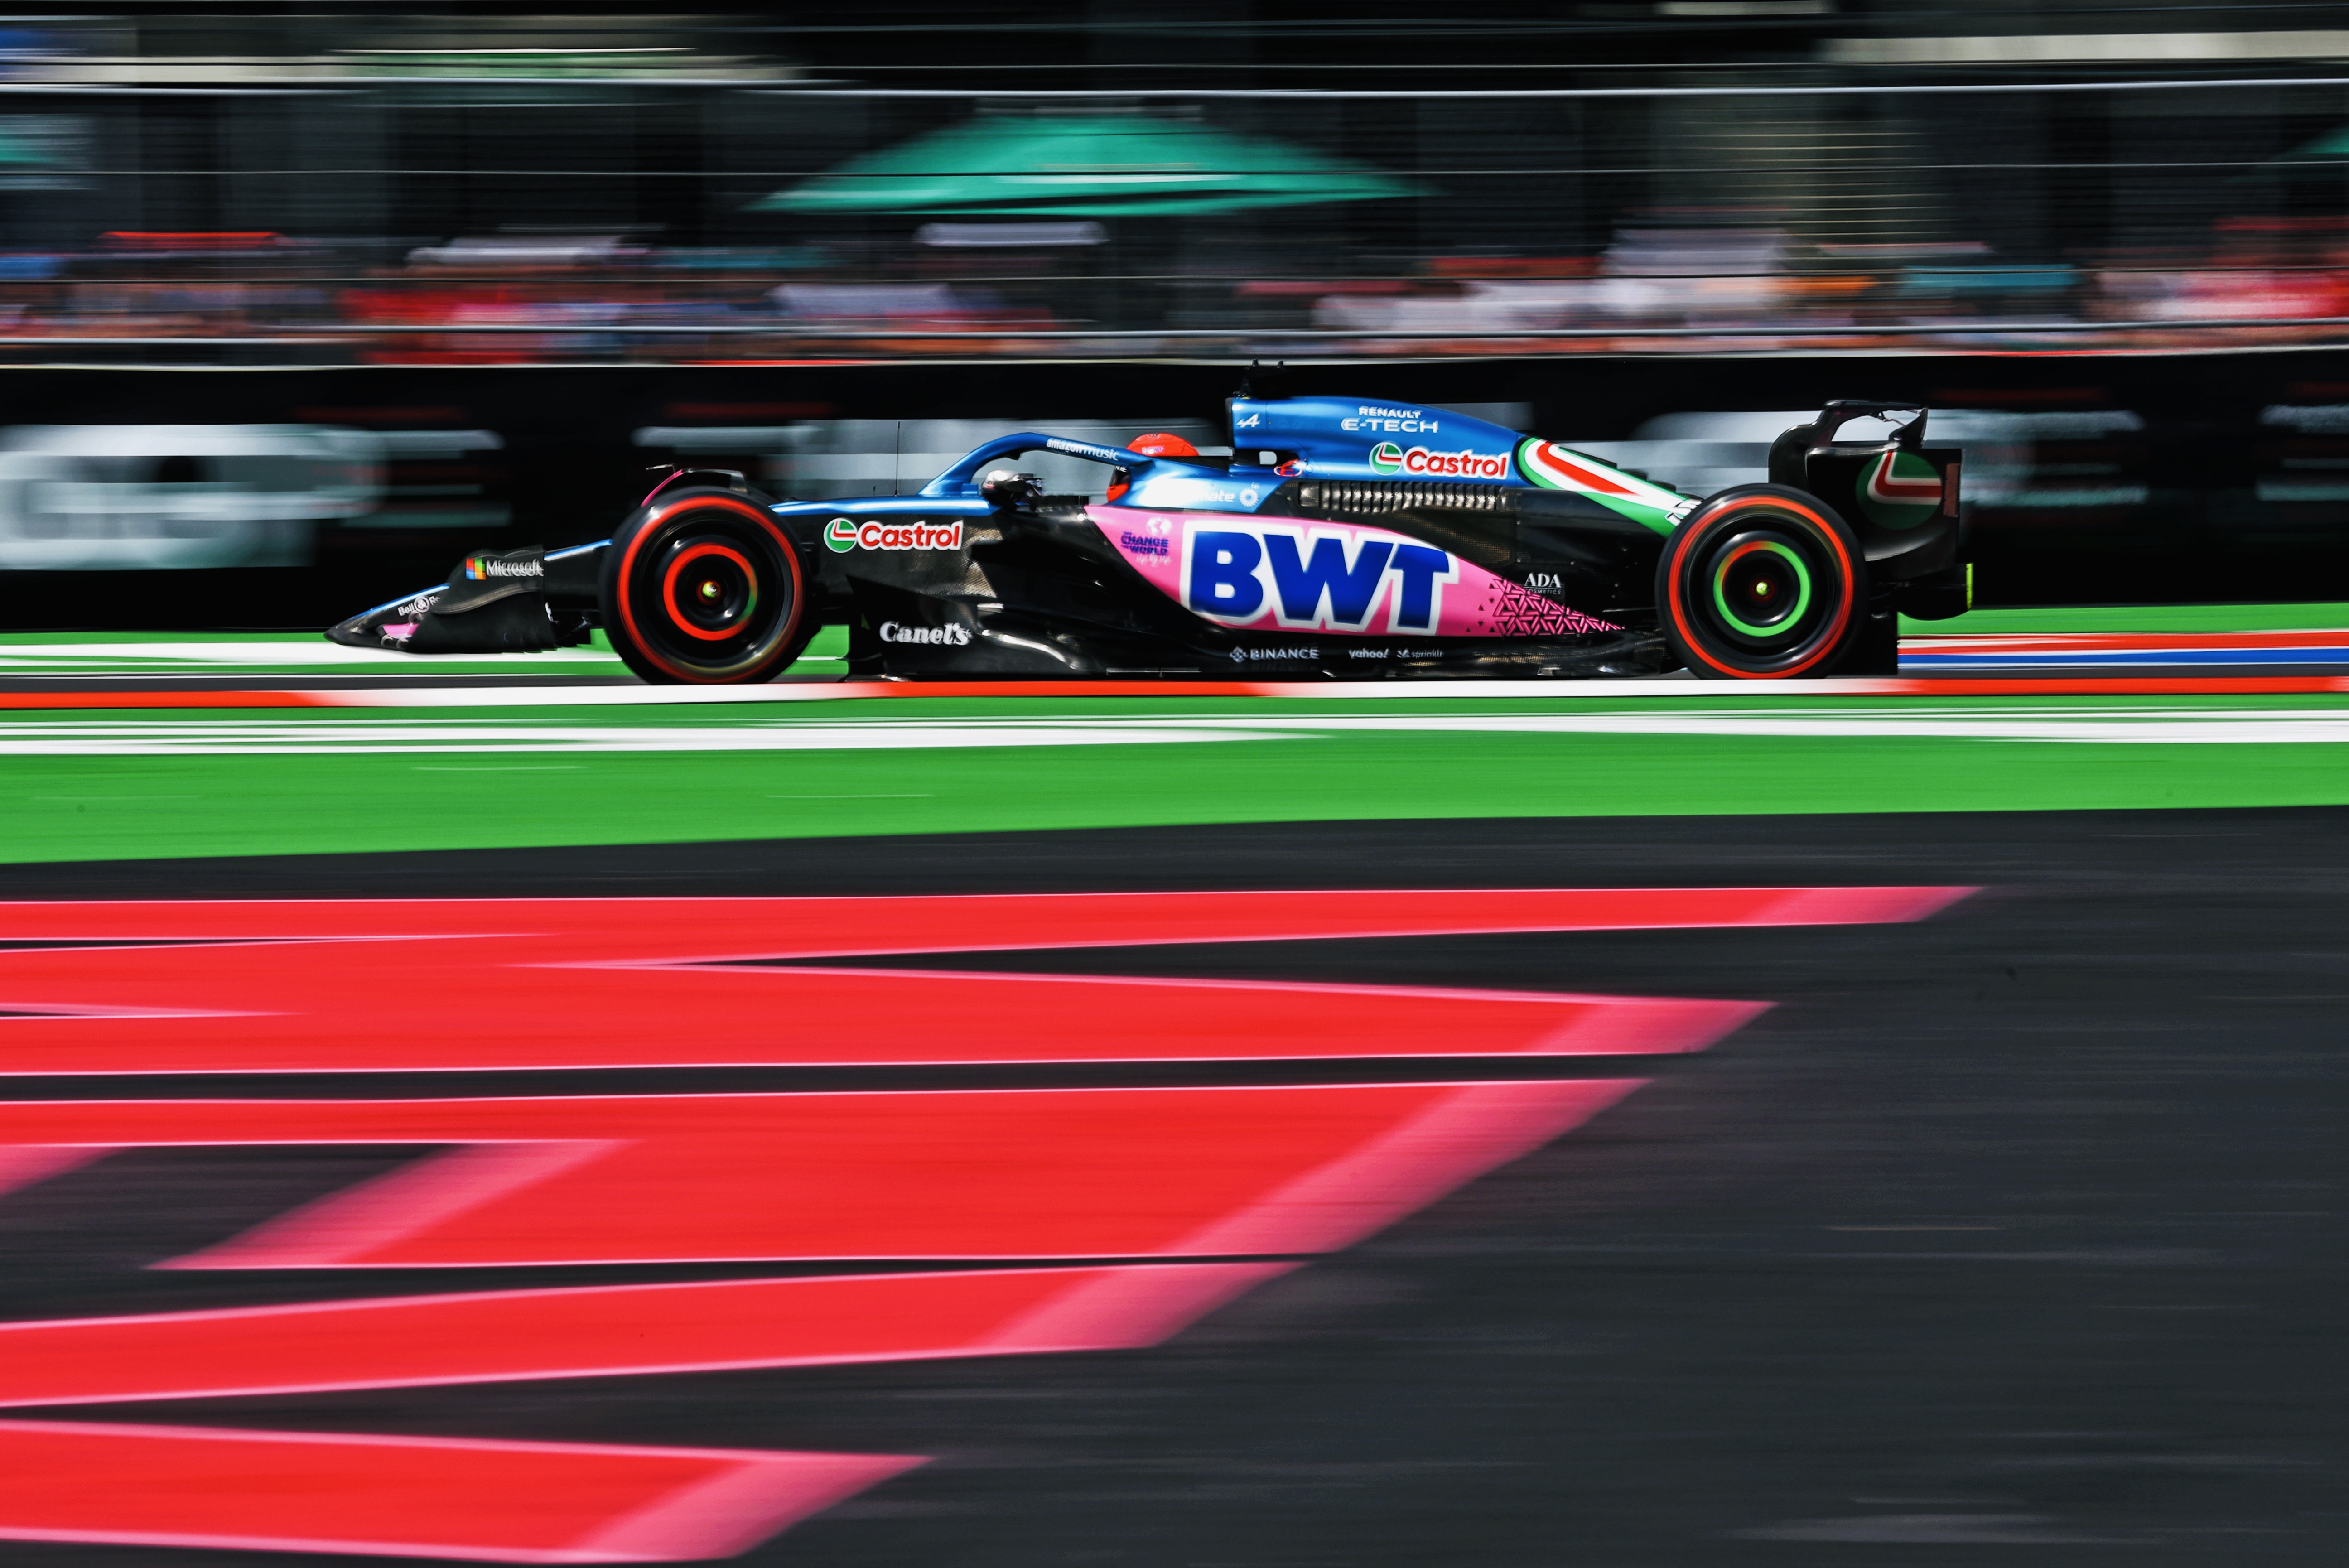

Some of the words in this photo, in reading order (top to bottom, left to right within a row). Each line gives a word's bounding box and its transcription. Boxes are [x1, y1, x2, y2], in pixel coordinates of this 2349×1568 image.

[1359, 406, 1423, 419] RENAULT
[1341, 418, 1438, 433] E-TECH
[1406, 450, 1506, 477] Castrol
[861, 525, 960, 547] Castrol
[1120, 536, 1168, 548] CHANGE
[1130, 545, 1168, 556] WORLD
[486, 559, 544, 576] Microsoft
[1189, 531, 1449, 629] BWT
[1524, 572, 1562, 588] ADA
[398, 603, 415, 616] Bell
[879, 621, 970, 646] Canel's
[1250, 648, 1320, 660] BINANCE
[1348, 647, 1389, 659] yahoo!
[1411, 647, 1443, 660] sprinklr
